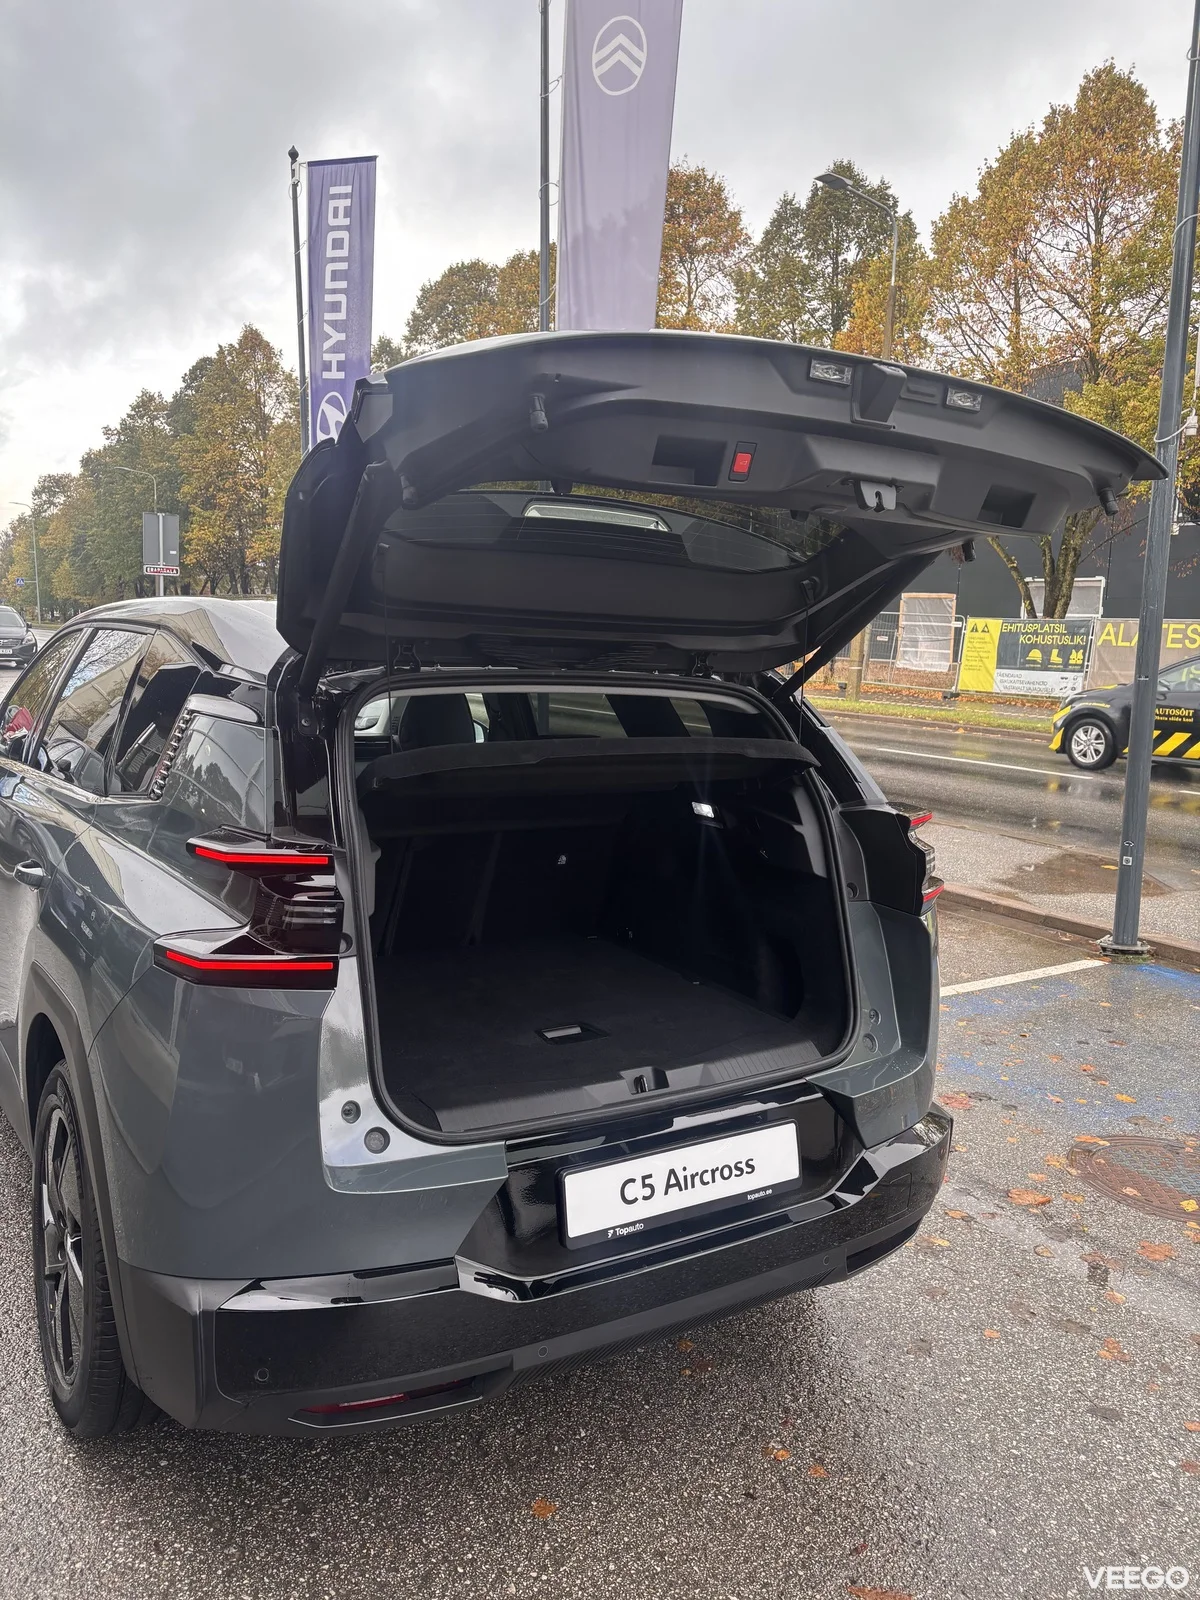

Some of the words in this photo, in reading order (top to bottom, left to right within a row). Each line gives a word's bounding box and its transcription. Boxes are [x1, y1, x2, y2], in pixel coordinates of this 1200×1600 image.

[322, 185, 353, 380] HYUNDAI
[1001, 623, 1068, 634] EHITUSPLATSIL
[1097, 622, 1200, 648] ALES
[1019, 634, 1087, 645] KOHUSTUSLIK!
[620, 1173, 656, 1206] C5
[663, 1157, 756, 1196] Aircross
[747, 1187, 773, 1201] topauto.ee
[614, 1222, 645, 1237] Topauto
